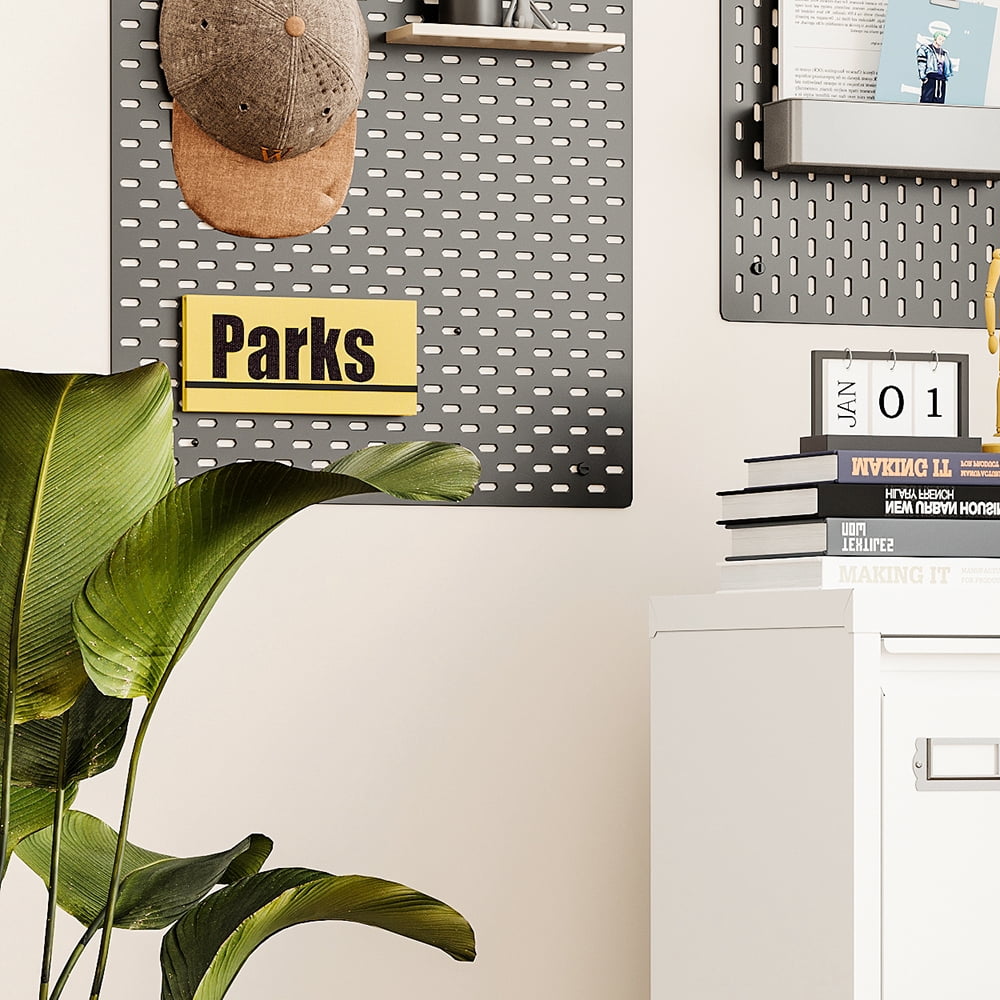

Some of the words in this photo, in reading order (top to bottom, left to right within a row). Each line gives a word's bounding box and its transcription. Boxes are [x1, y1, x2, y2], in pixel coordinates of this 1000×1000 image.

[211, 313, 376, 383] Parks
[837, 380, 857, 427] JAN
[926, 387, 943, 418] 1
[838, 565, 924, 584] MAKING
[929, 566, 951, 584] IT
